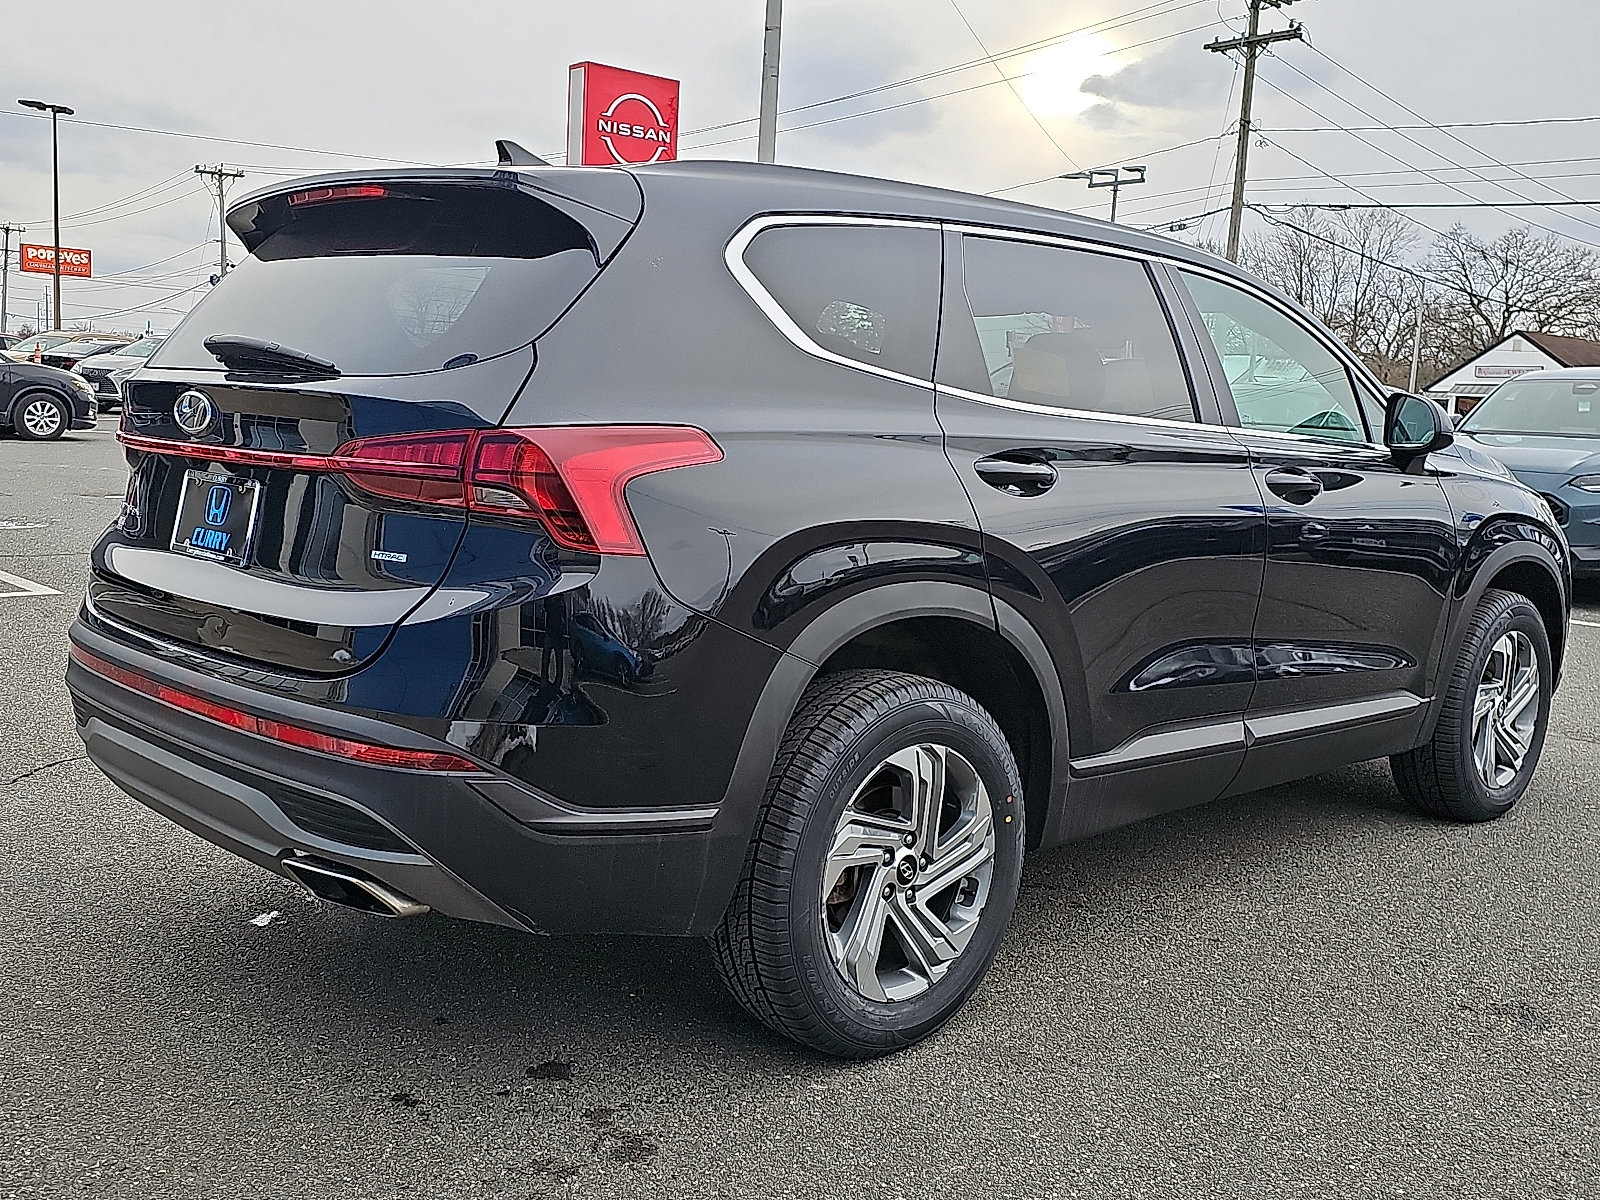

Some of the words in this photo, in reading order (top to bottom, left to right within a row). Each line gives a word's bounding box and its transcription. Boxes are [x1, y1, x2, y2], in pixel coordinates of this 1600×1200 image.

[598, 119, 671, 143] NISSAN
[191, 527, 231, 551] CURRY
[374, 552, 405, 561] HTRAC
[829, 751, 861, 799] OUTSIDE
